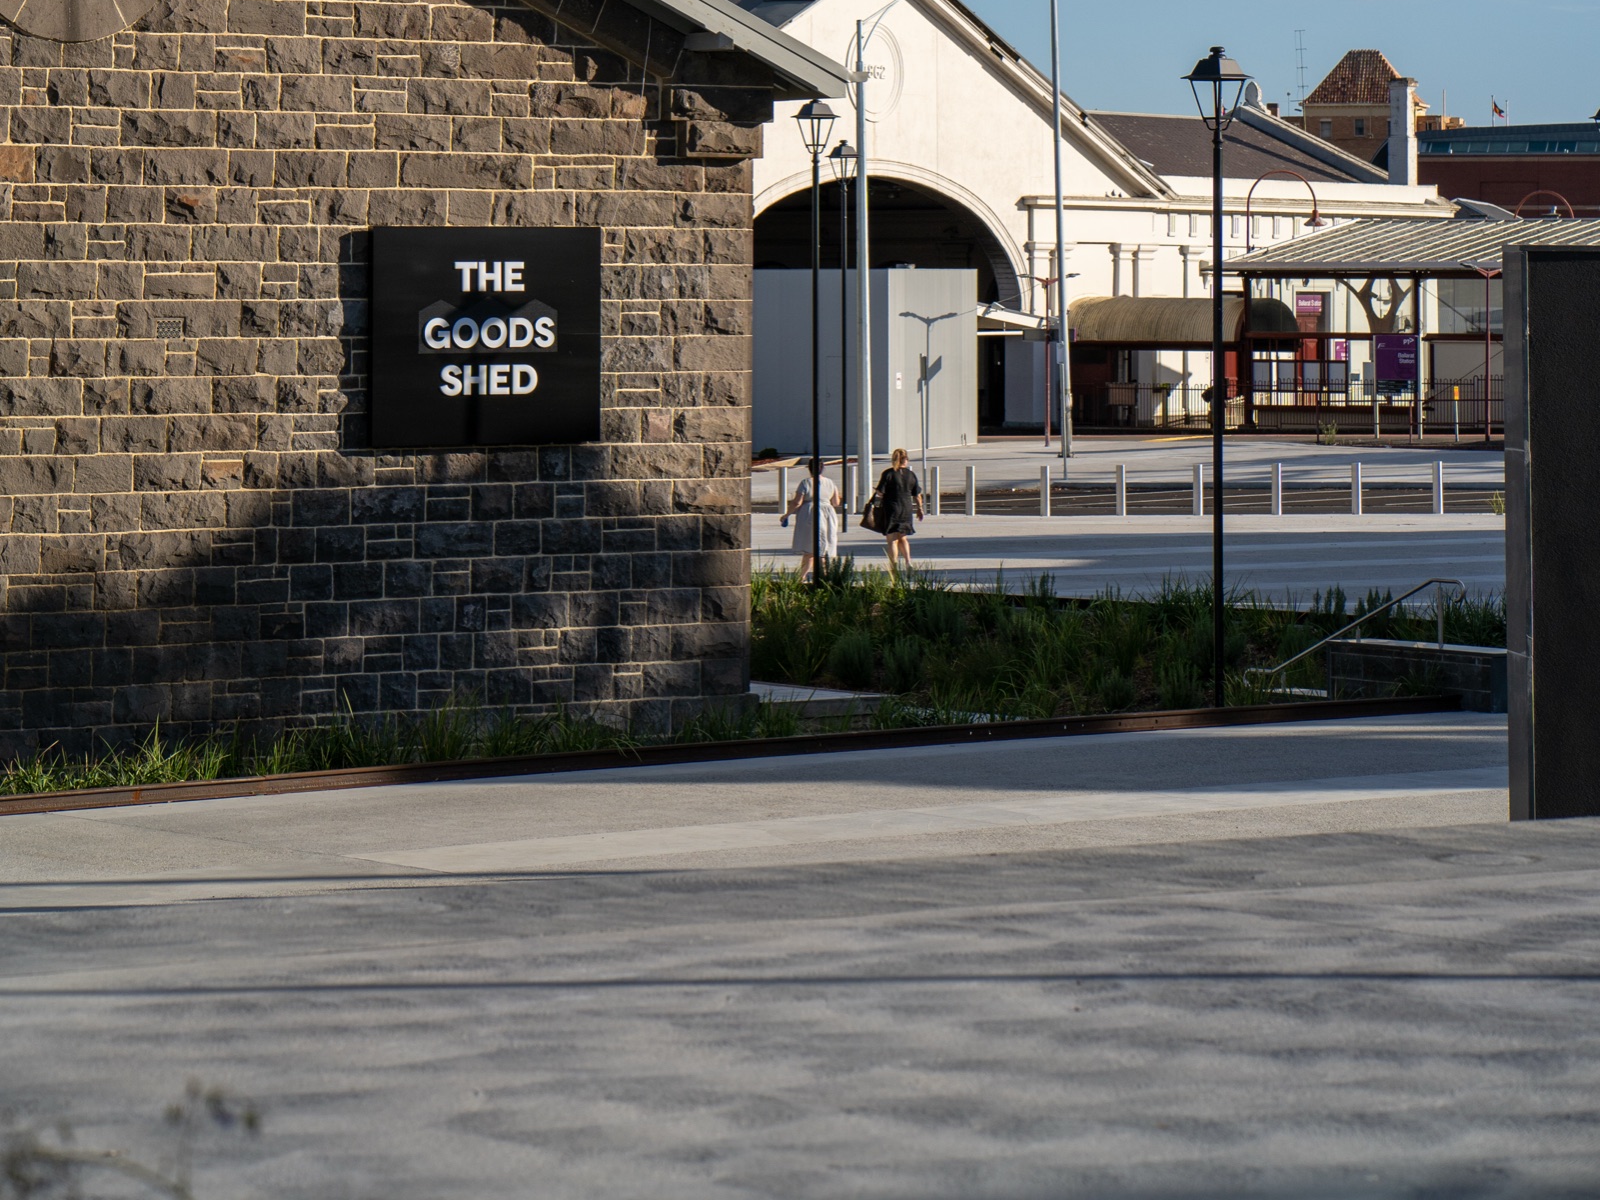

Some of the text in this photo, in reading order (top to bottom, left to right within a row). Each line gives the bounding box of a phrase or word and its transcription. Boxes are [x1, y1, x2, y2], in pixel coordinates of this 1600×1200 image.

[455, 261, 525, 292] THE
[424, 316, 556, 350] GOODS
[440, 364, 539, 397] SHED
